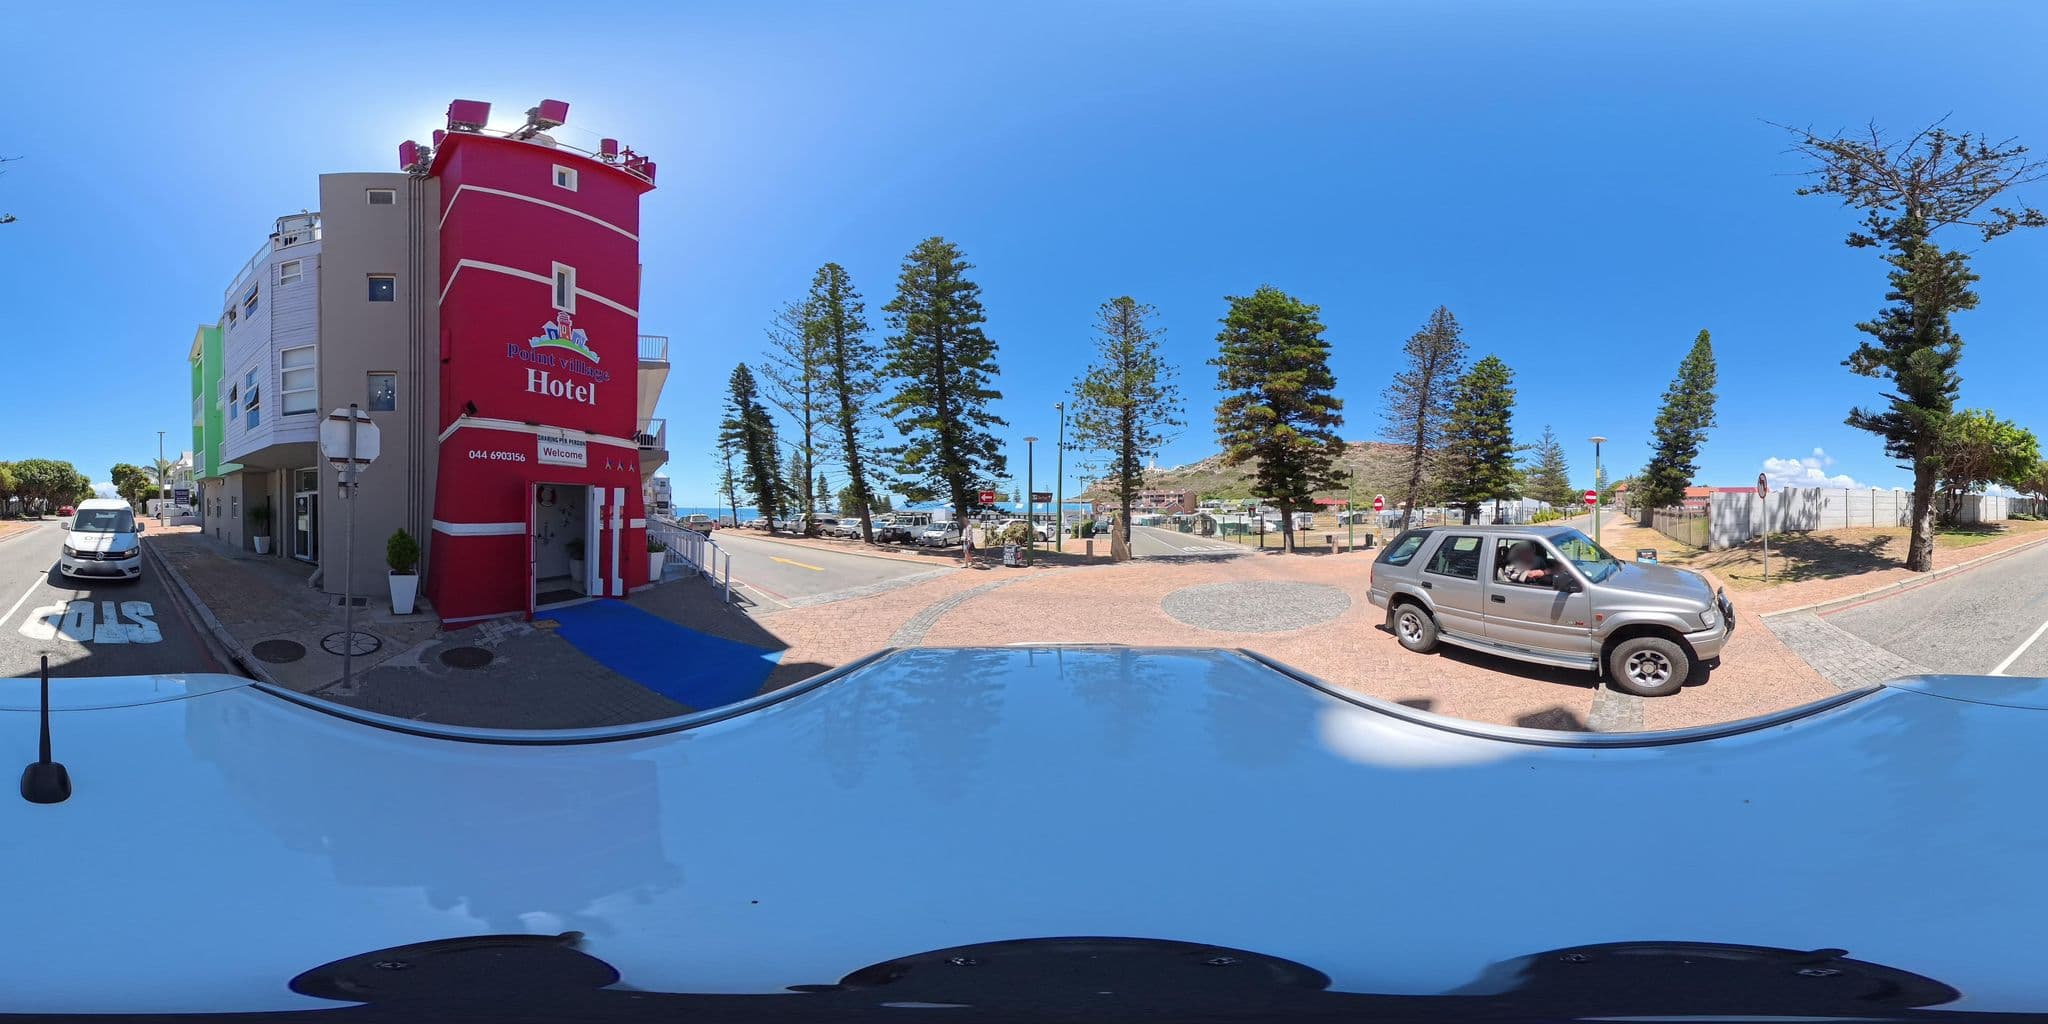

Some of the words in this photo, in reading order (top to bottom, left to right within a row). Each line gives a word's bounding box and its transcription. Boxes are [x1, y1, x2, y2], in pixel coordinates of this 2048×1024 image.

[507, 343, 555, 367] Point
[560, 358, 610, 382] village
[525, 368, 596, 405] Hotel
[469, 450, 488, 459] 044
[490, 451, 526, 462] 6903156
[543, 447, 583, 460] Welcome
[18, 600, 162, 643] STOP
